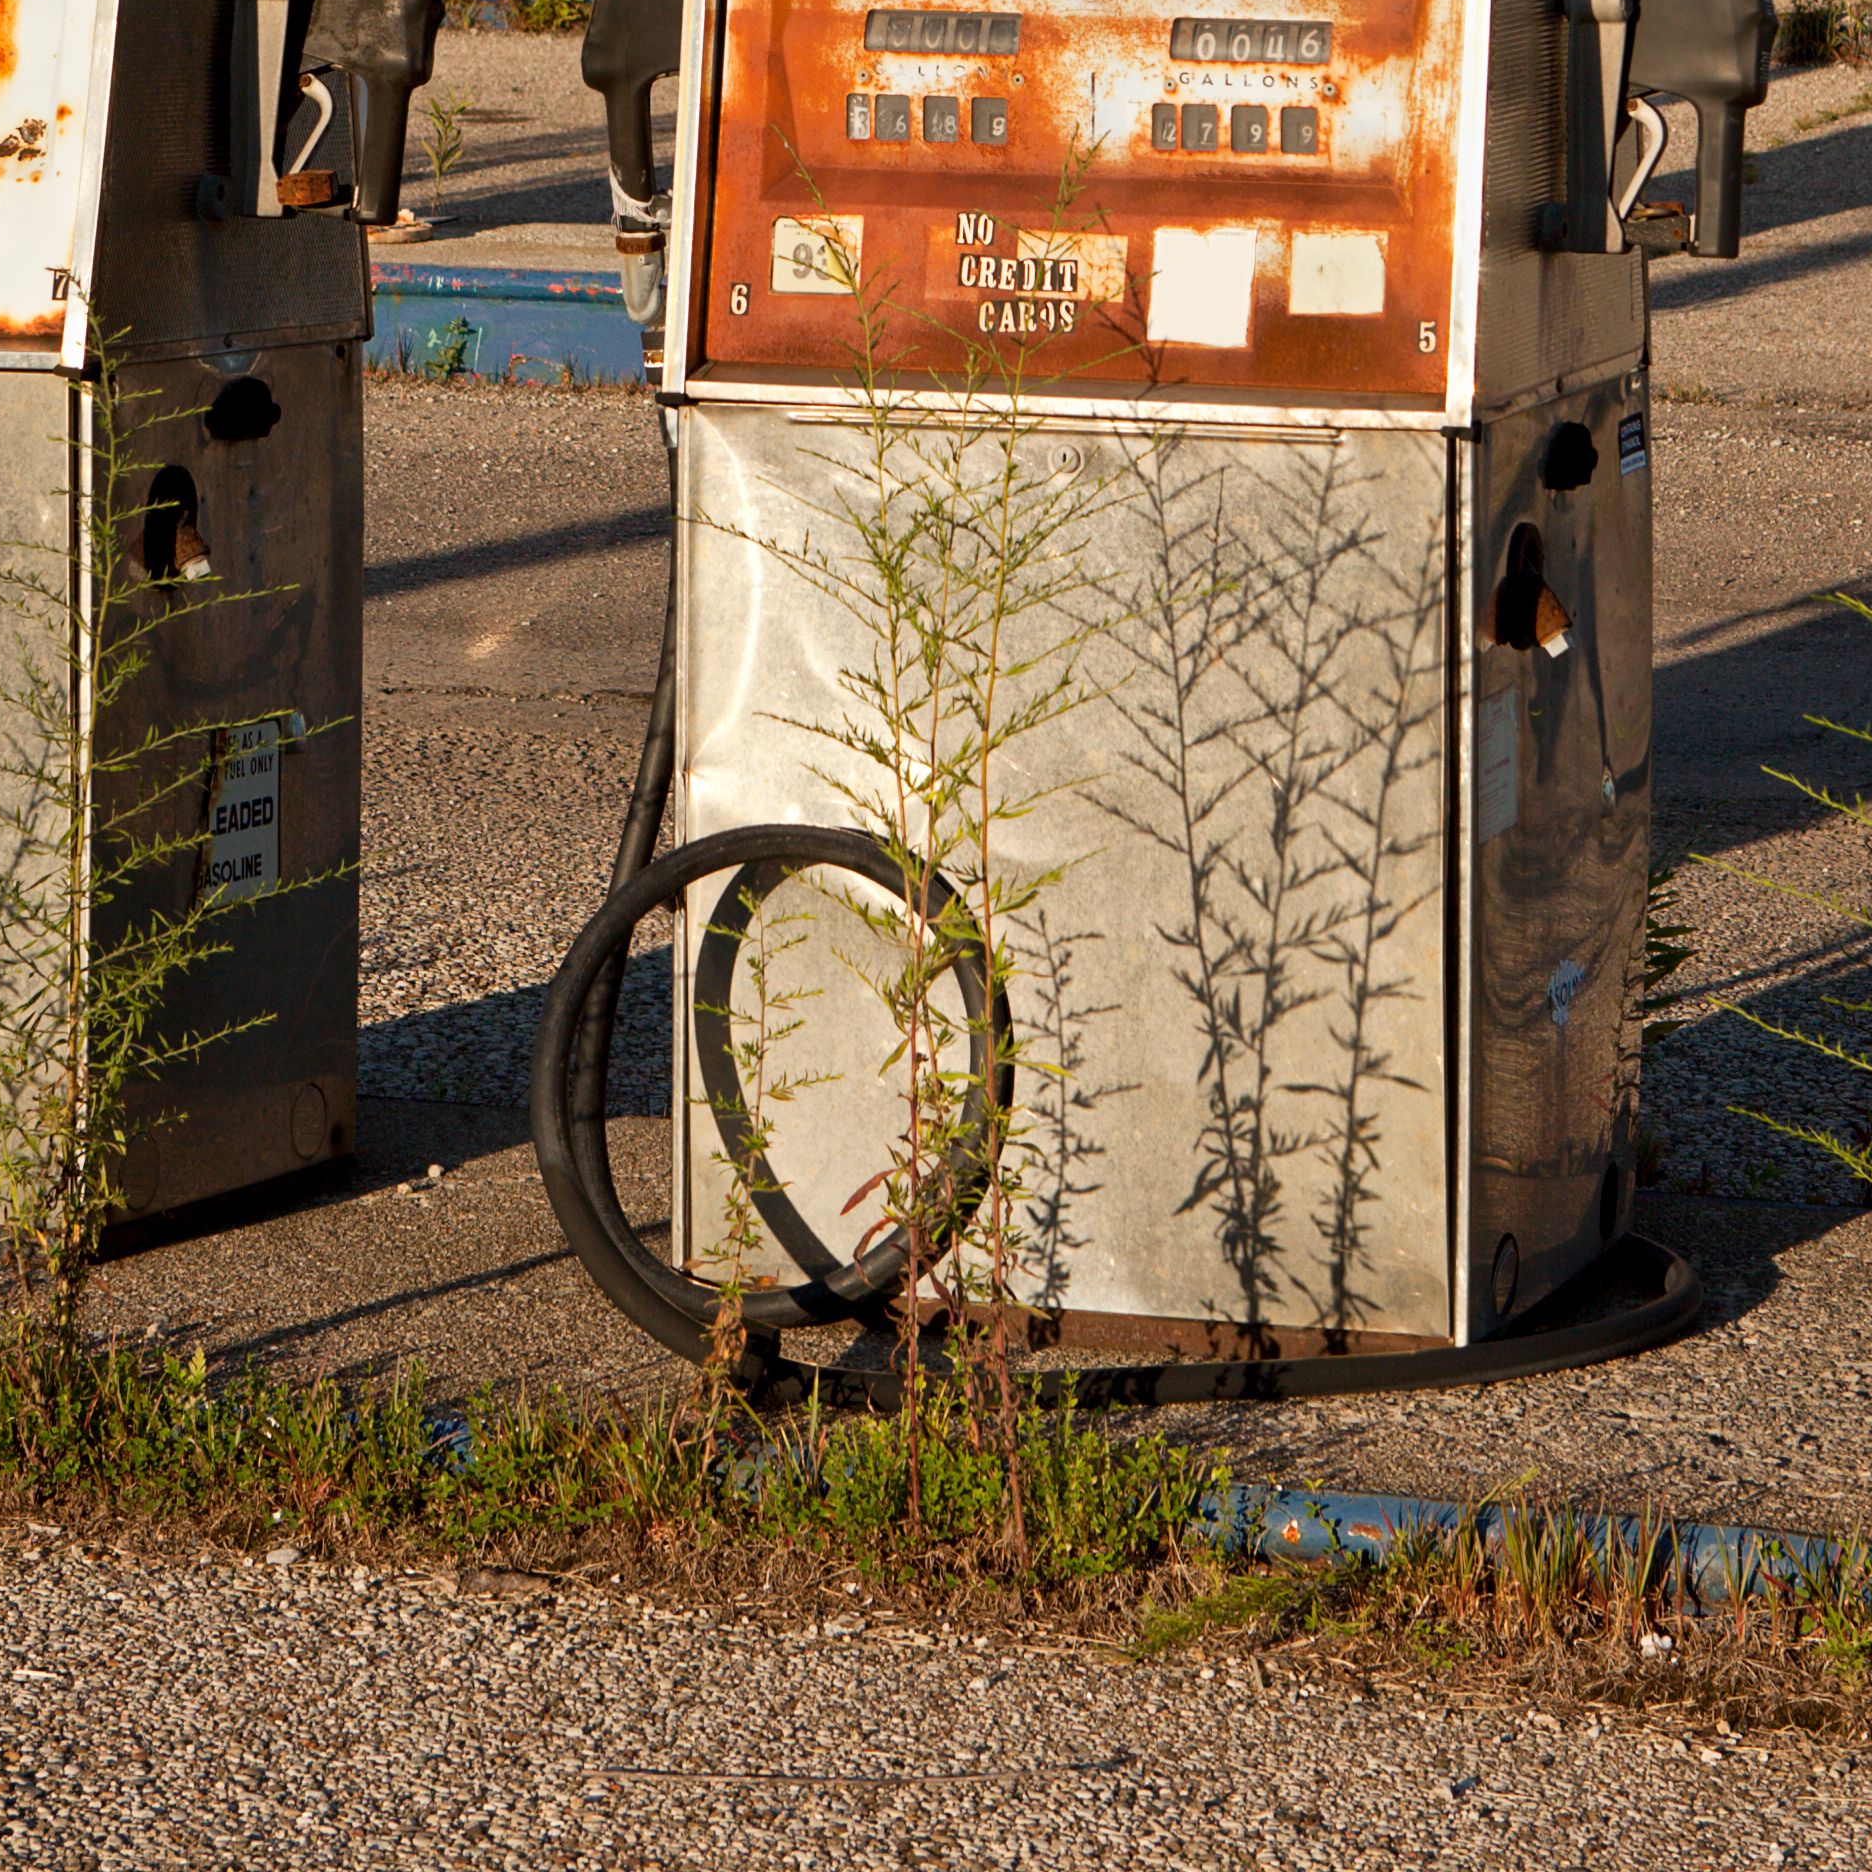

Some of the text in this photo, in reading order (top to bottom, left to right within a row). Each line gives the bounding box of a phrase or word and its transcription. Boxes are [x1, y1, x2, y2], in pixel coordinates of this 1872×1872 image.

[1179, 73, 1318, 89] GALLONS
[957, 213, 993, 245] NO
[55, 272, 69, 299] 7
[961, 256, 1076, 291] CREDIT
[731, 284, 747, 315] 6
[1419, 322, 1437, 352] 5
[242, 732, 253, 750] AS
[250, 754, 274, 775] ONLY
